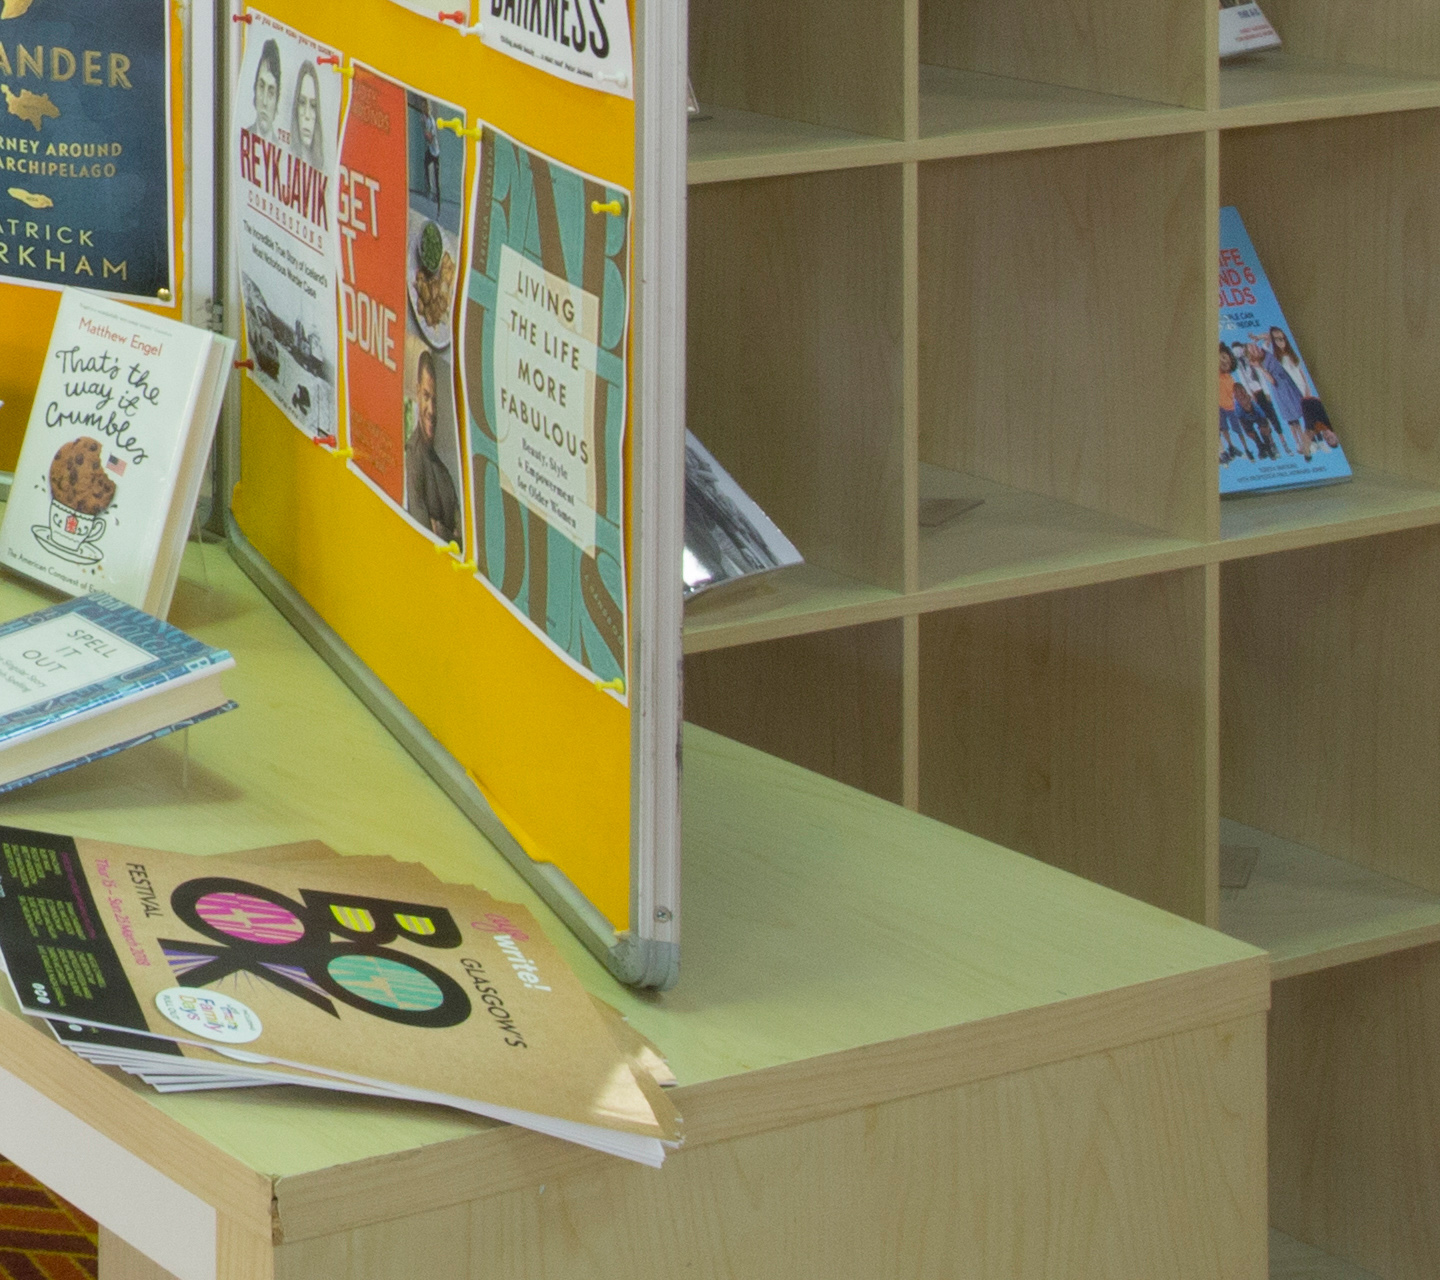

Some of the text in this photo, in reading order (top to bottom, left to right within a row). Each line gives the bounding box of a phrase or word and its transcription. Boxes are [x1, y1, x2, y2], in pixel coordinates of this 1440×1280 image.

[45, 141, 123, 158] AROUND
[240, 127, 328, 232] REYKJAVIK
[337, 164, 380, 240] GET
[517, 271, 575, 323] LIVING
[79, 317, 127, 344] Matthew
[130, 333, 163, 357] Engel
[343, 282, 398, 371] DONE
[510, 310, 580, 371] THE LIFE
[55, 345, 160, 407] That's the
[64, 381, 139, 417] way it
[518, 358, 567, 408] MORE
[45, 401, 149, 465] Crumbles
[500, 387, 589, 465] FABULOUS
[21, 649, 68, 675] OUT
[55, 645, 83, 658] IT
[66, 629, 119, 659] SPELL
[126, 862, 164, 919] FESTIVAL
[493, 934, 552, 993] write!
[460, 957, 528, 1049] GLASGOW'S
